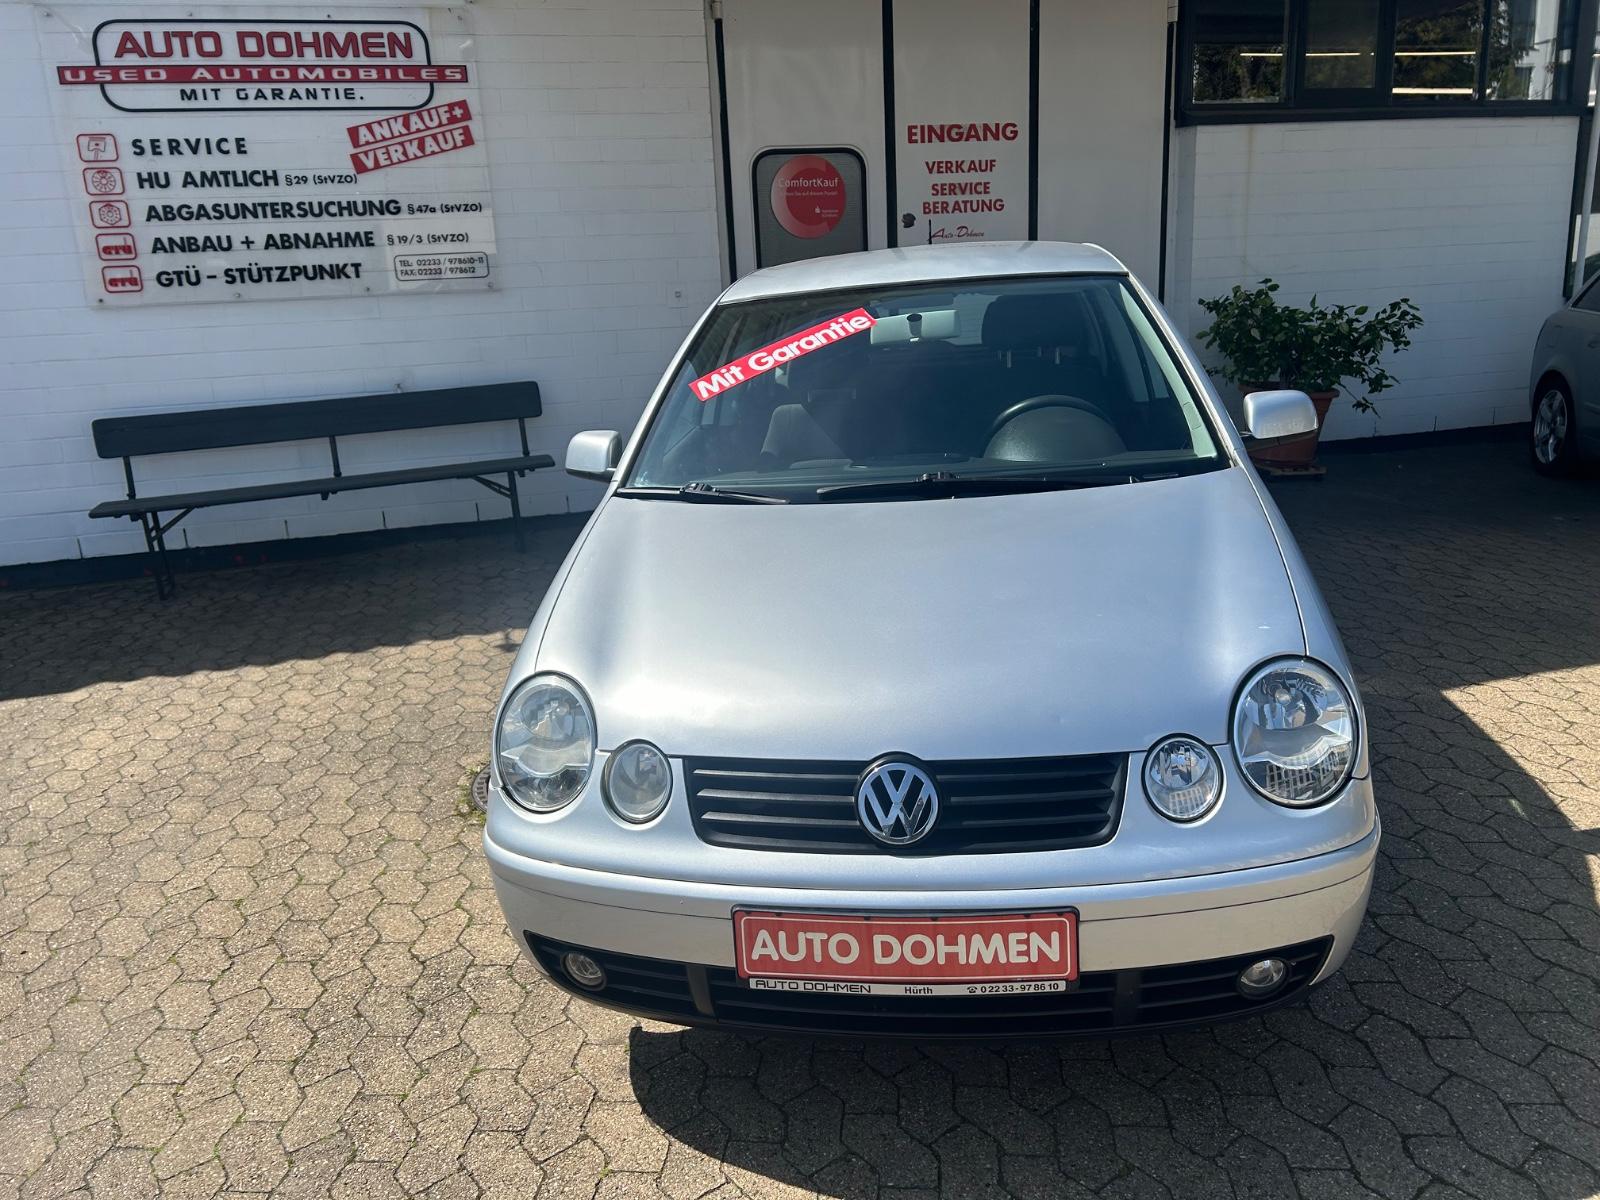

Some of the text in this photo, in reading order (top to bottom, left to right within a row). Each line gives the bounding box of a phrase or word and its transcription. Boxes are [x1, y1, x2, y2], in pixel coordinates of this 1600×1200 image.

[114, 31, 413, 59] AUTO DOHMEN
[64, 67, 463, 82] USED AUTOMOBILES
[180, 87, 365, 101] MIT GARANTIE.
[907, 122, 1019, 144] EINGANG
[131, 137, 248, 156] SERVICE
[358, 129, 466, 170] VERKAUF
[925, 159, 997, 174] VERKAUF
[136, 171, 171, 189] HU
[181, 169, 279, 188] AMTLICH
[312, 173, 358, 185] (StVZO)
[779, 177, 840, 188] ComfortKauf
[931, 181, 991, 197] SERVICE
[145, 199, 402, 223] ABGASUNTERSUCHUNG
[440, 202, 483, 214] (StVZO)
[922, 198, 1005, 215] BERATUNG
[151, 235, 233, 254] ANBAU
[263, 231, 376, 250] ABNAHME
[155, 265, 202, 288] GTÜ
[223, 262, 363, 285] STÜTZPUNKT
[697, 313, 871, 398] Mit Garantie
[751, 929, 1060, 965] AUTO DOHMEN
[755, 980, 799, 991] AUTO
[803, 981, 872, 994] DOHMEN
[904, 985, 934, 996] Hürth
